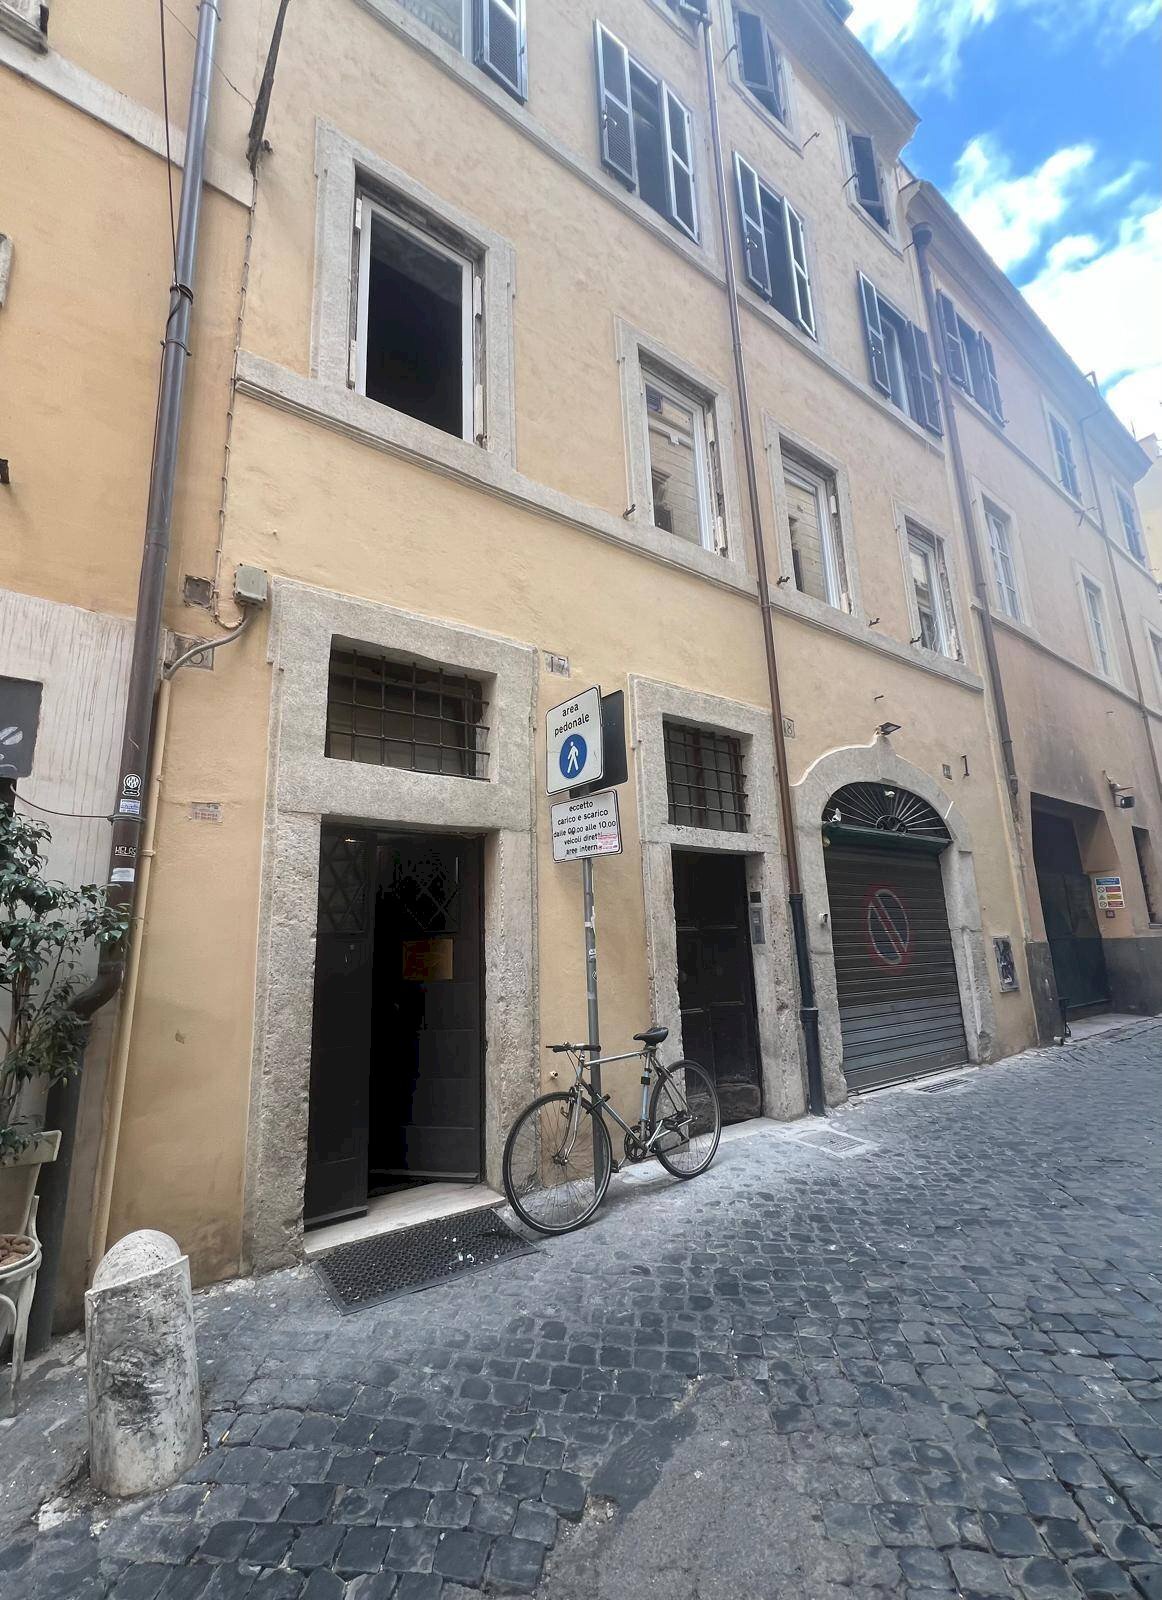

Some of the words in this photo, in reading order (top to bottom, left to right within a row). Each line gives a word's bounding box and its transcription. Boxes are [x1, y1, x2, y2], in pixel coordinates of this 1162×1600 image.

[562, 703, 579, 717] area
[554, 713, 590, 738] pedonale
[569, 801, 593, 812] eccetto
[557, 815, 576, 826] carico
[583, 809, 608, 820] scarico
[585, 823, 597, 831] alle
